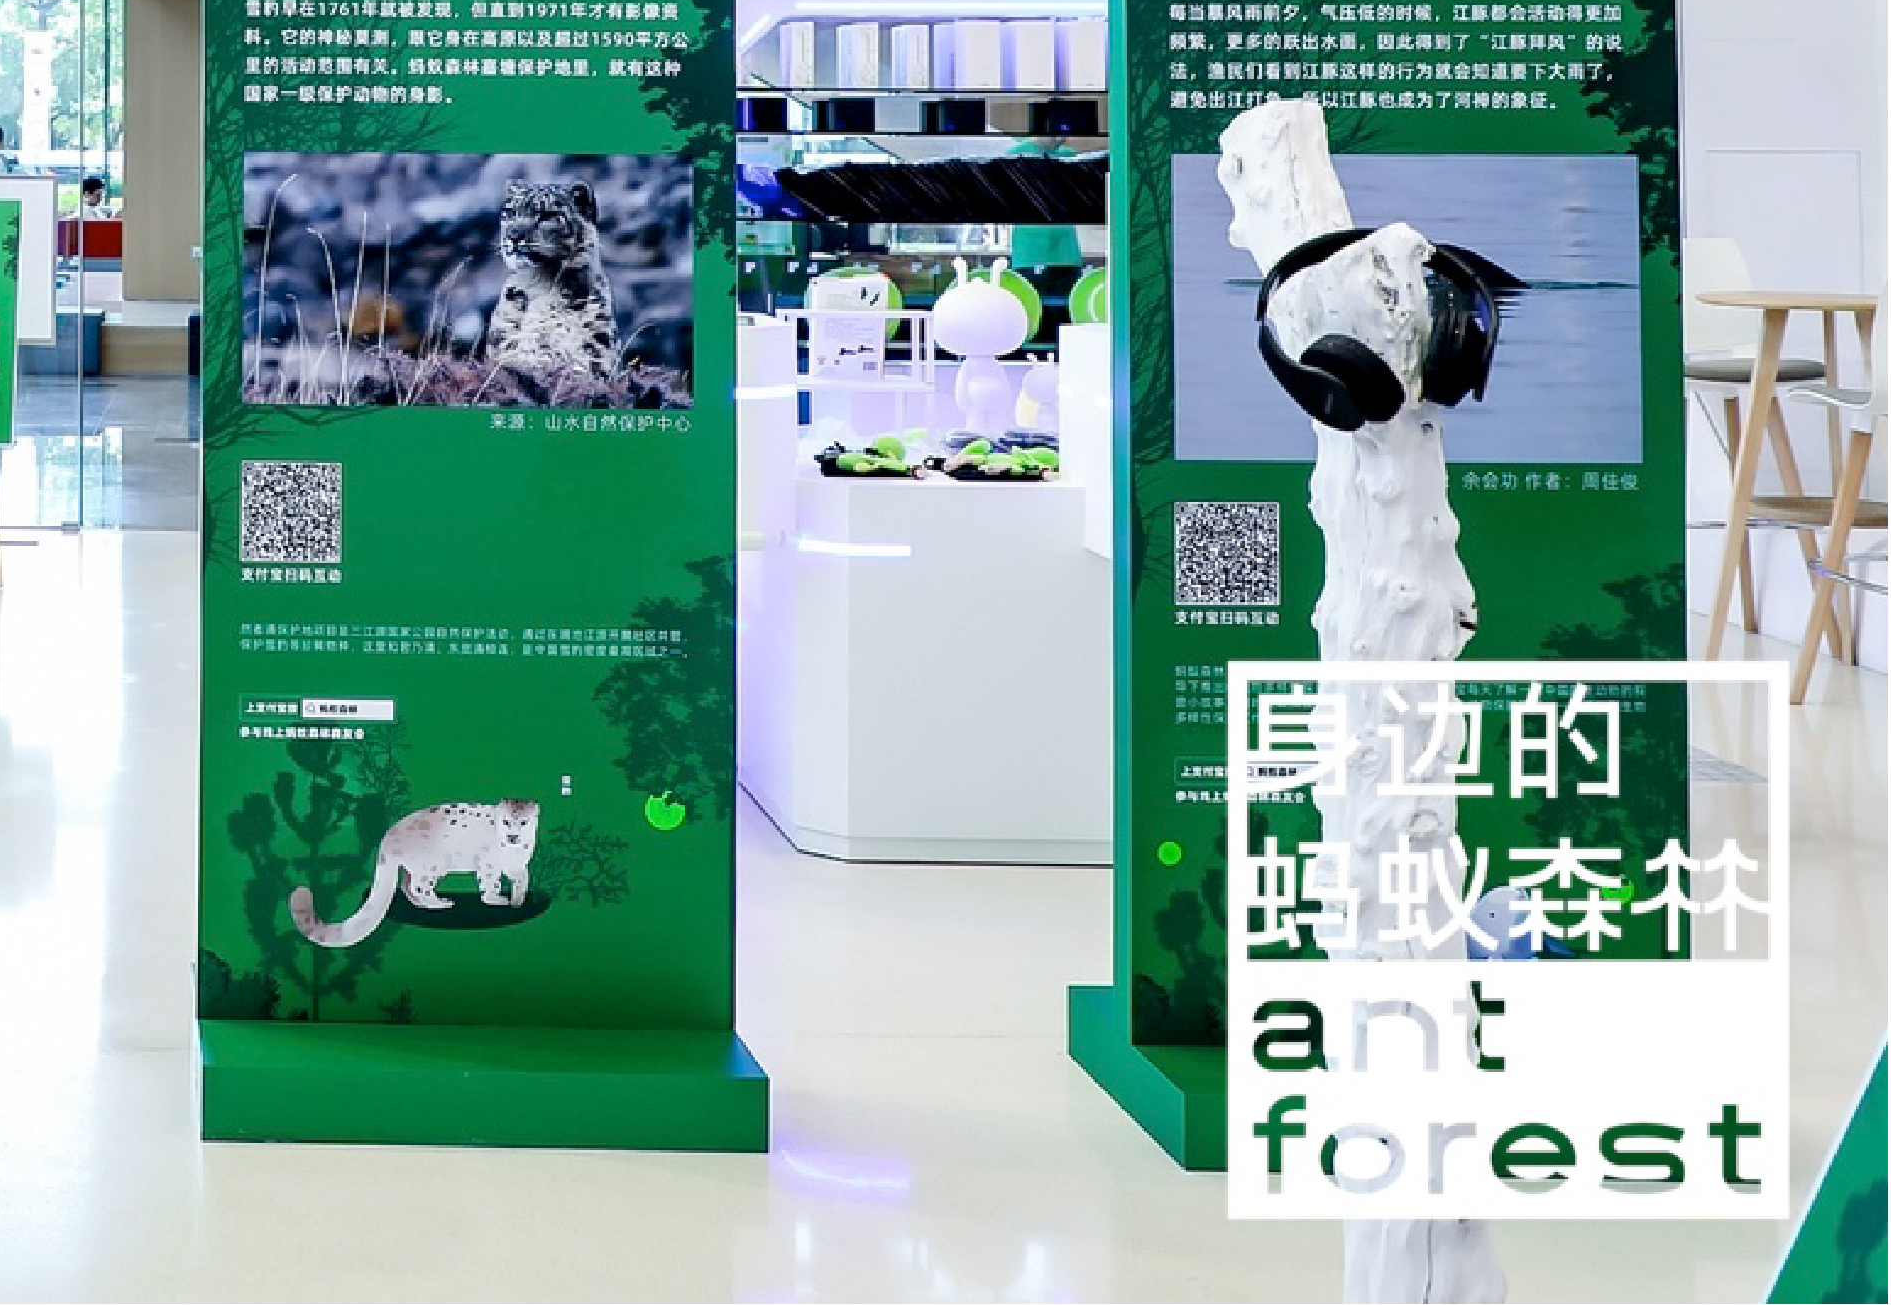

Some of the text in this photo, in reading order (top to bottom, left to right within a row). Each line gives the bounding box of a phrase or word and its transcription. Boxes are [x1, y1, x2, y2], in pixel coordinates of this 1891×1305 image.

[240, 566, 343, 584] 支付宝扫码互动
[1174, 610, 1280, 626] 支付宝扫码互动
